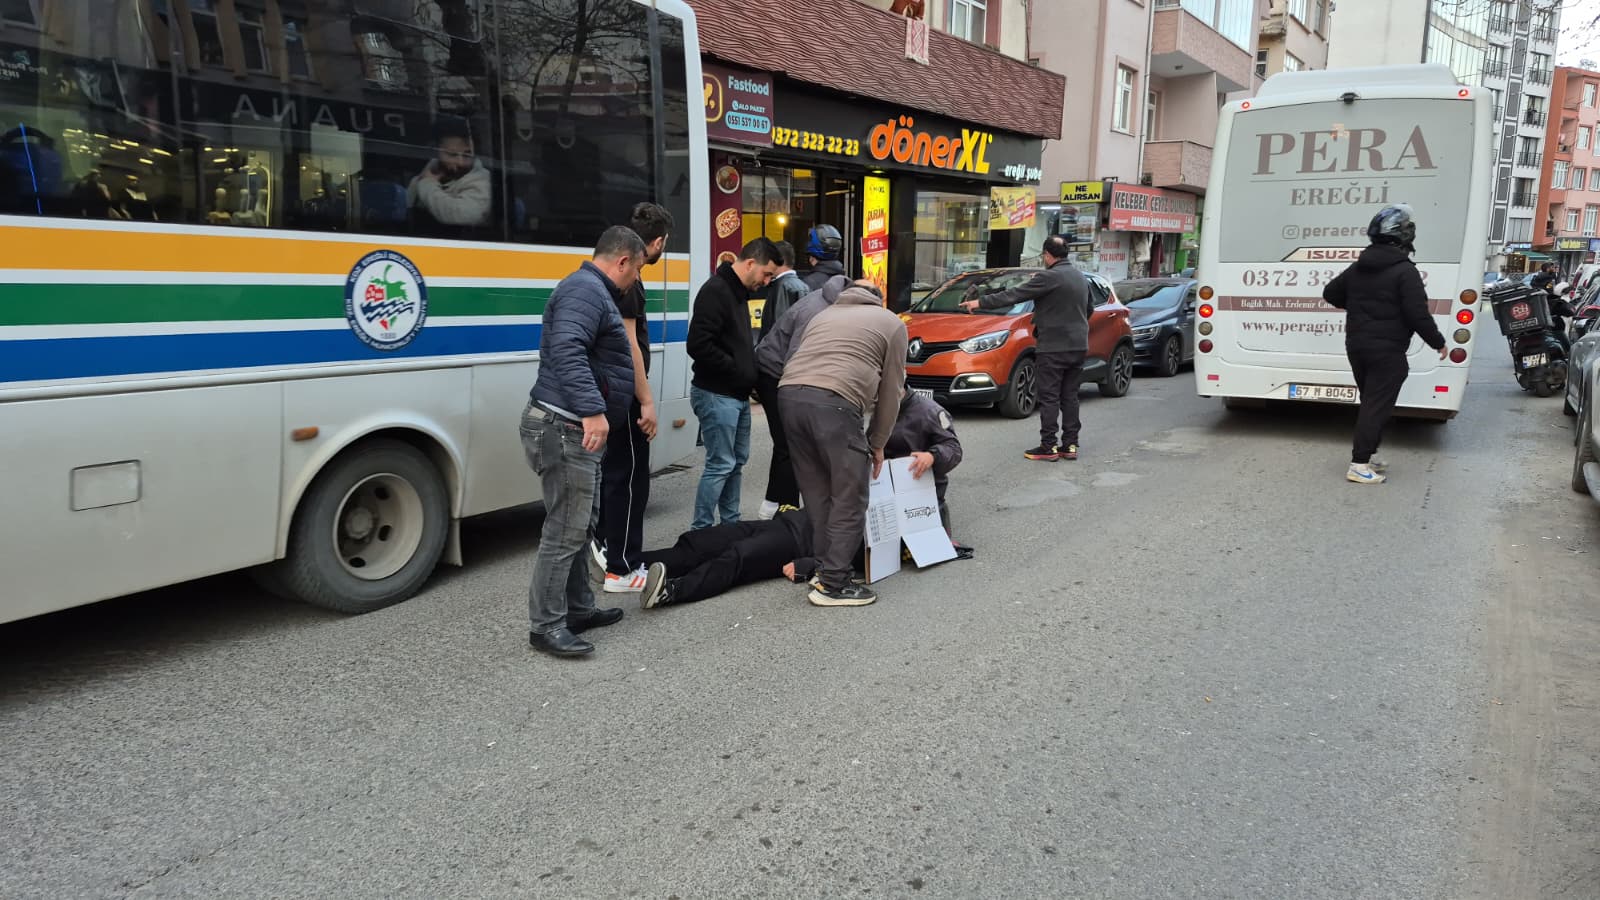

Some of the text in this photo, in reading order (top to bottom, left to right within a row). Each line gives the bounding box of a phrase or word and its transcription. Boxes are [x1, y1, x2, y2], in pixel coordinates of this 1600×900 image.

[728, 75, 769, 97] Fastfood
[749, 105, 766, 113] PAKET
[727, 114, 740, 125] 0551
[741, 116, 752, 126] 537
[752, 118, 760, 128] 00
[801, 131, 825, 151] 323
[827, 136, 844, 154] 22
[845, 139, 860, 156] 23
[1252, 125, 1438, 175] PERA
[1075, 184, 1087, 192] NE
[1289, 181, 1391, 206] EREĞLİ
[1063, 193, 1101, 201] ALIRSAN
[1114, 191, 1148, 211] KELEBEK
[1302, 226, 1368, 239] peraere
[1242, 270, 1342, 287] 0372 33
[1265, 300, 1283, 308] Mah.
[1285, 299, 1316, 309] Erdemir
[1296, 386, 1309, 396] 67
[1326, 387, 1354, 399] 8045
